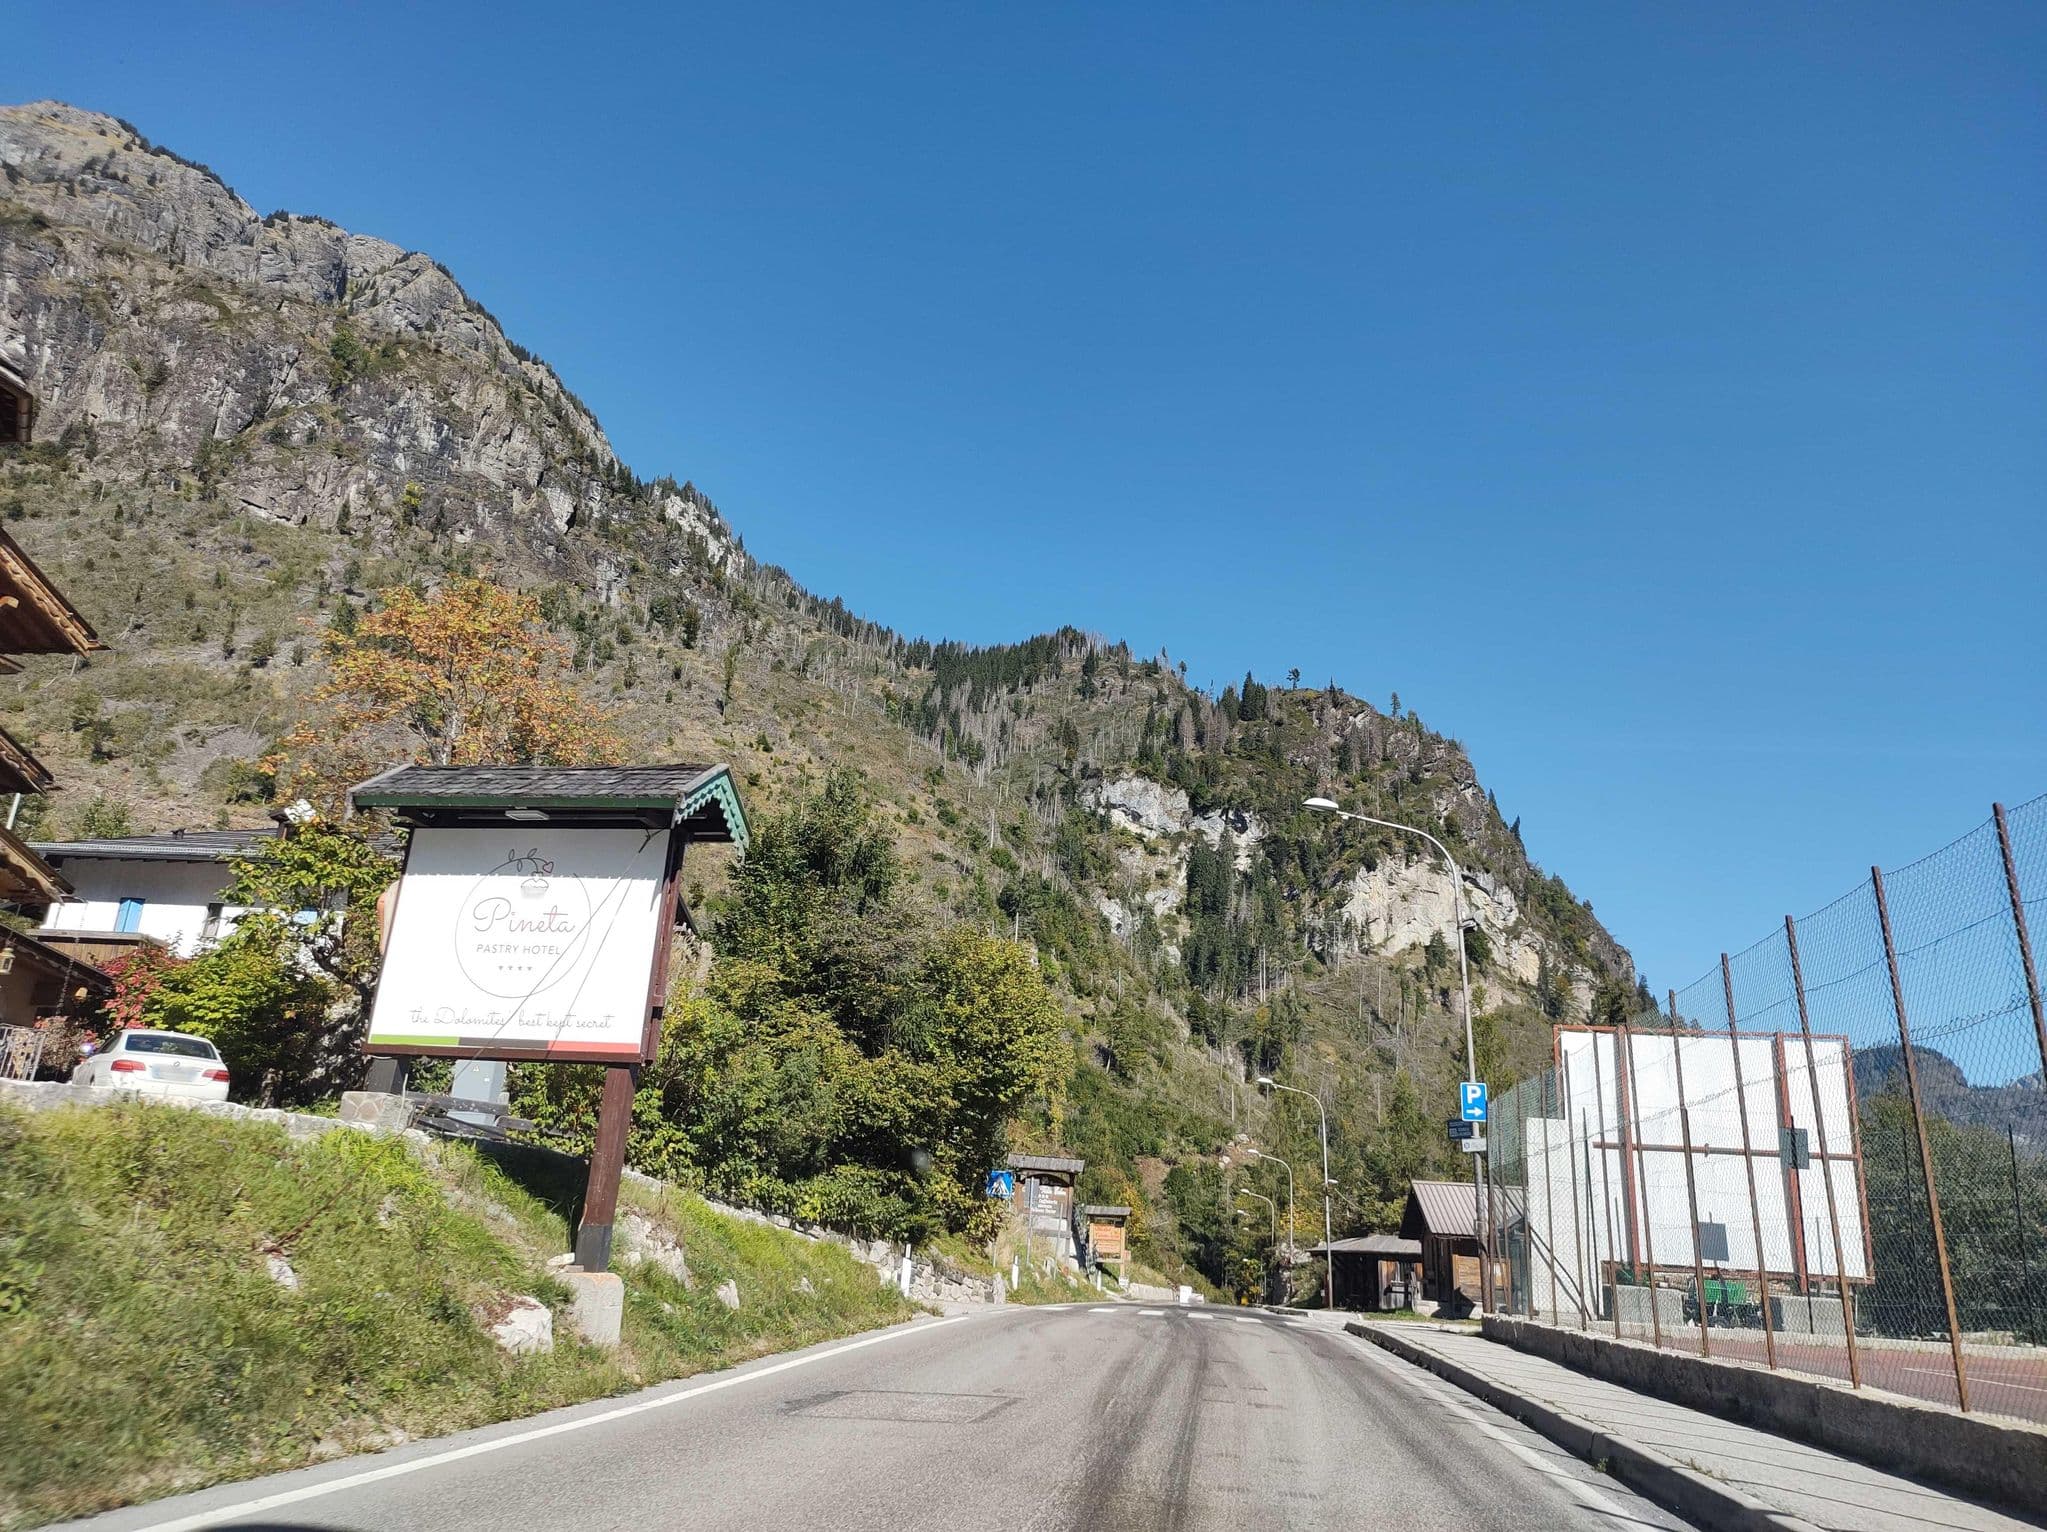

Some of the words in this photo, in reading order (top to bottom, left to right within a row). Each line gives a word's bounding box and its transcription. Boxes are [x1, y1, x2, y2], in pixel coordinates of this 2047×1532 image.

[472, 896, 576, 933] Pineta
[476, 943, 520, 954] PASTRY
[523, 945, 561, 955] HOTEL
[409, 1005, 430, 1024] the
[518, 1008, 547, 1027] best
[547, 1011, 577, 1032] kept
[576, 1014, 616, 1029] secret
[1466, 1085, 1482, 1104] P
